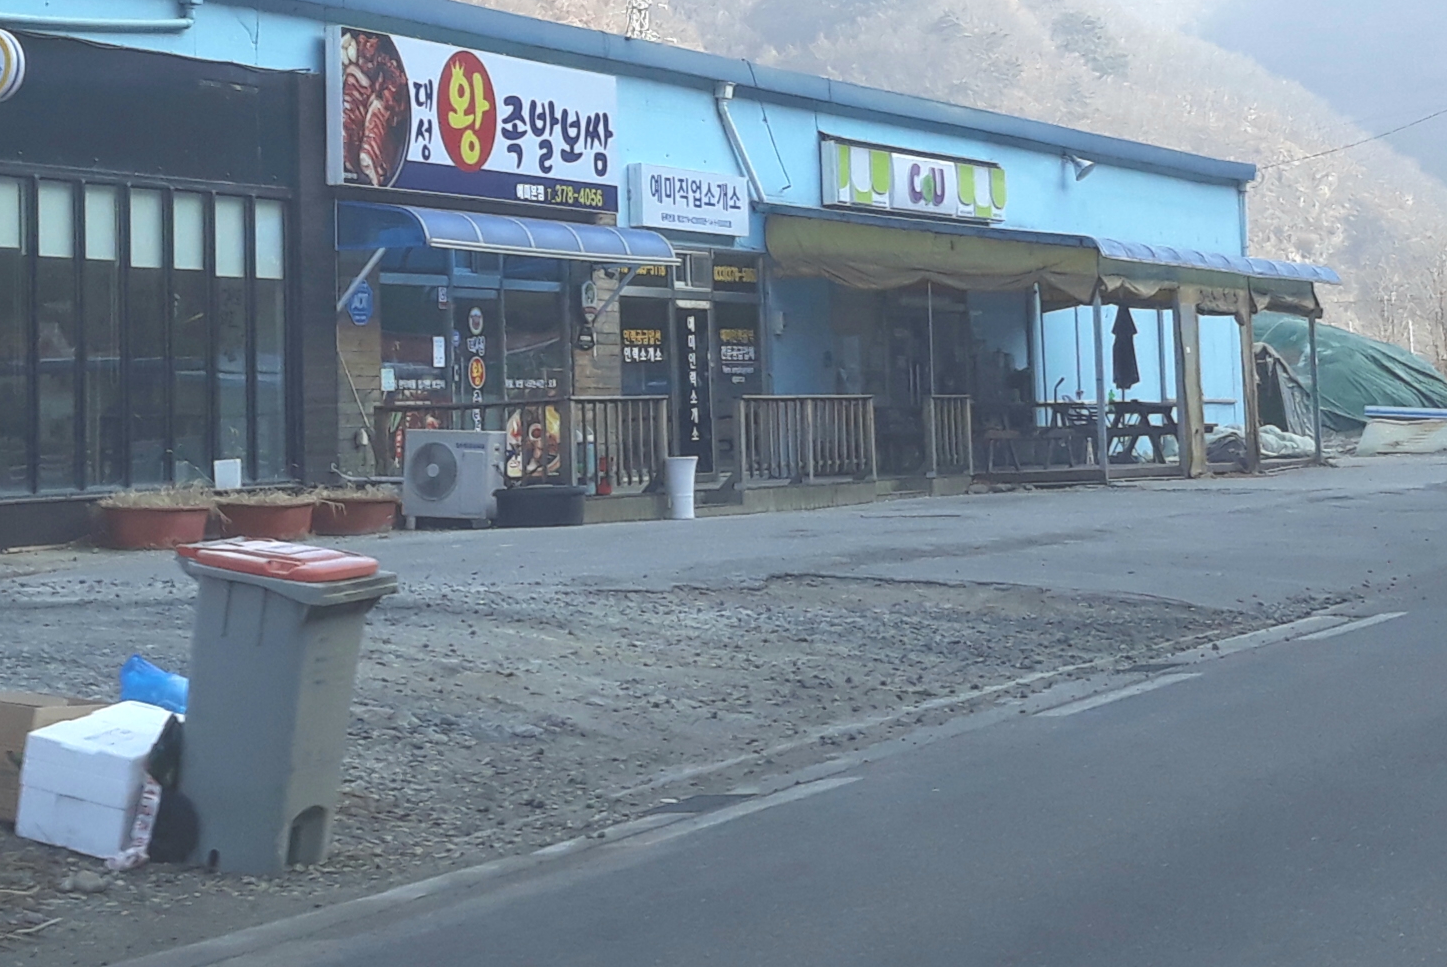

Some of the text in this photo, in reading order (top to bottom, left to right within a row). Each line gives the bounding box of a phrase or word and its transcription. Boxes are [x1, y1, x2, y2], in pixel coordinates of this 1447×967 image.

[413, 79, 433, 161] 대성
[448, 62, 491, 165] 왕
[650, 174, 742, 211] 예미직업소개소
[623, 347, 663, 363] 인력소개소
